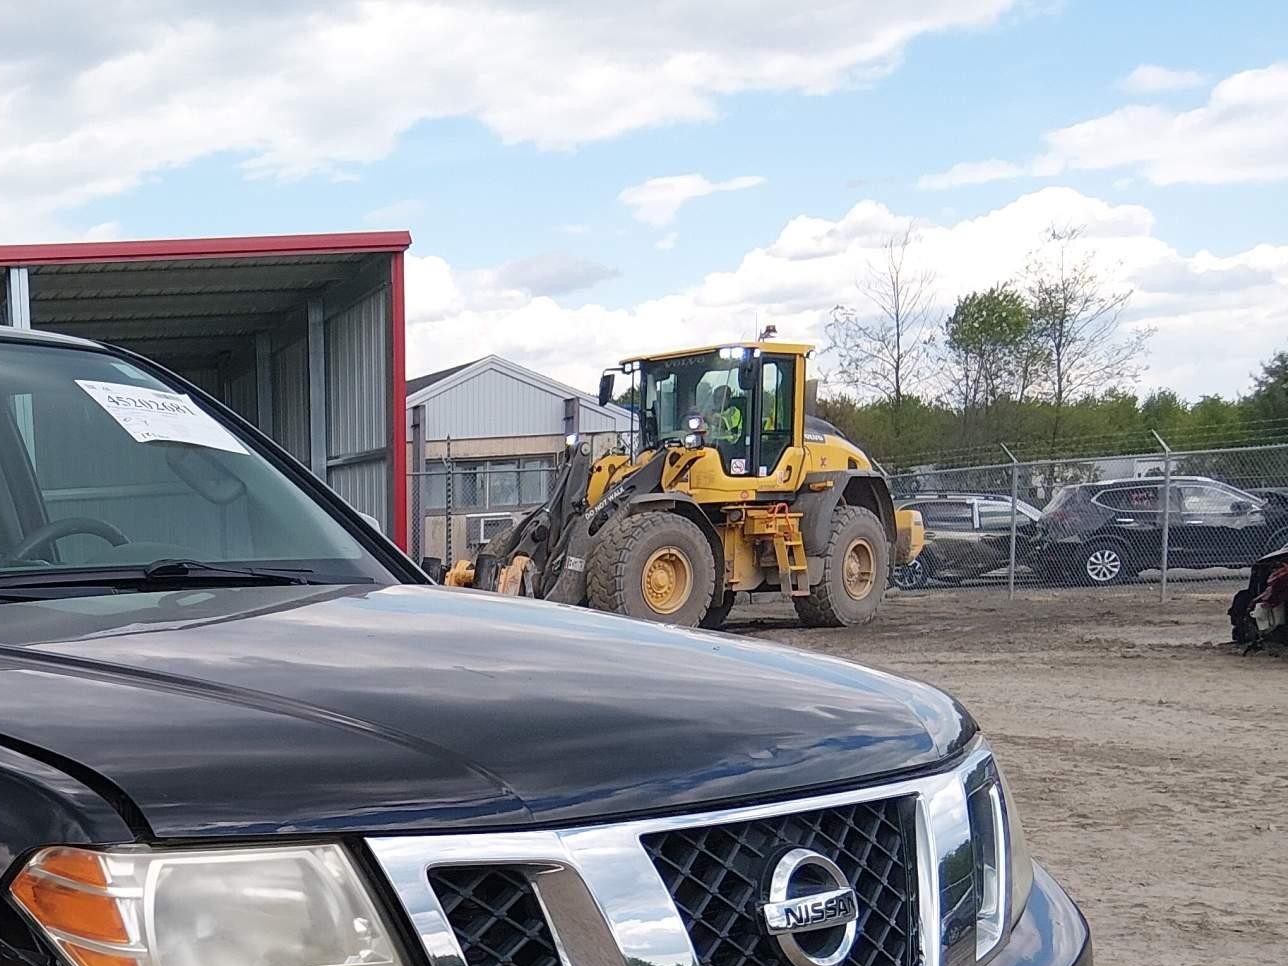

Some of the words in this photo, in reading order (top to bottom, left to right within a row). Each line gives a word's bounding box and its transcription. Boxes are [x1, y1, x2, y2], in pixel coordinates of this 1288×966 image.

[664, 356, 705, 369] VOLVO
[107, 394, 196, 416] 45202681
[584, 509, 595, 521] DO
[594, 499, 608, 513] NOT
[608, 486, 626, 502] WALK
